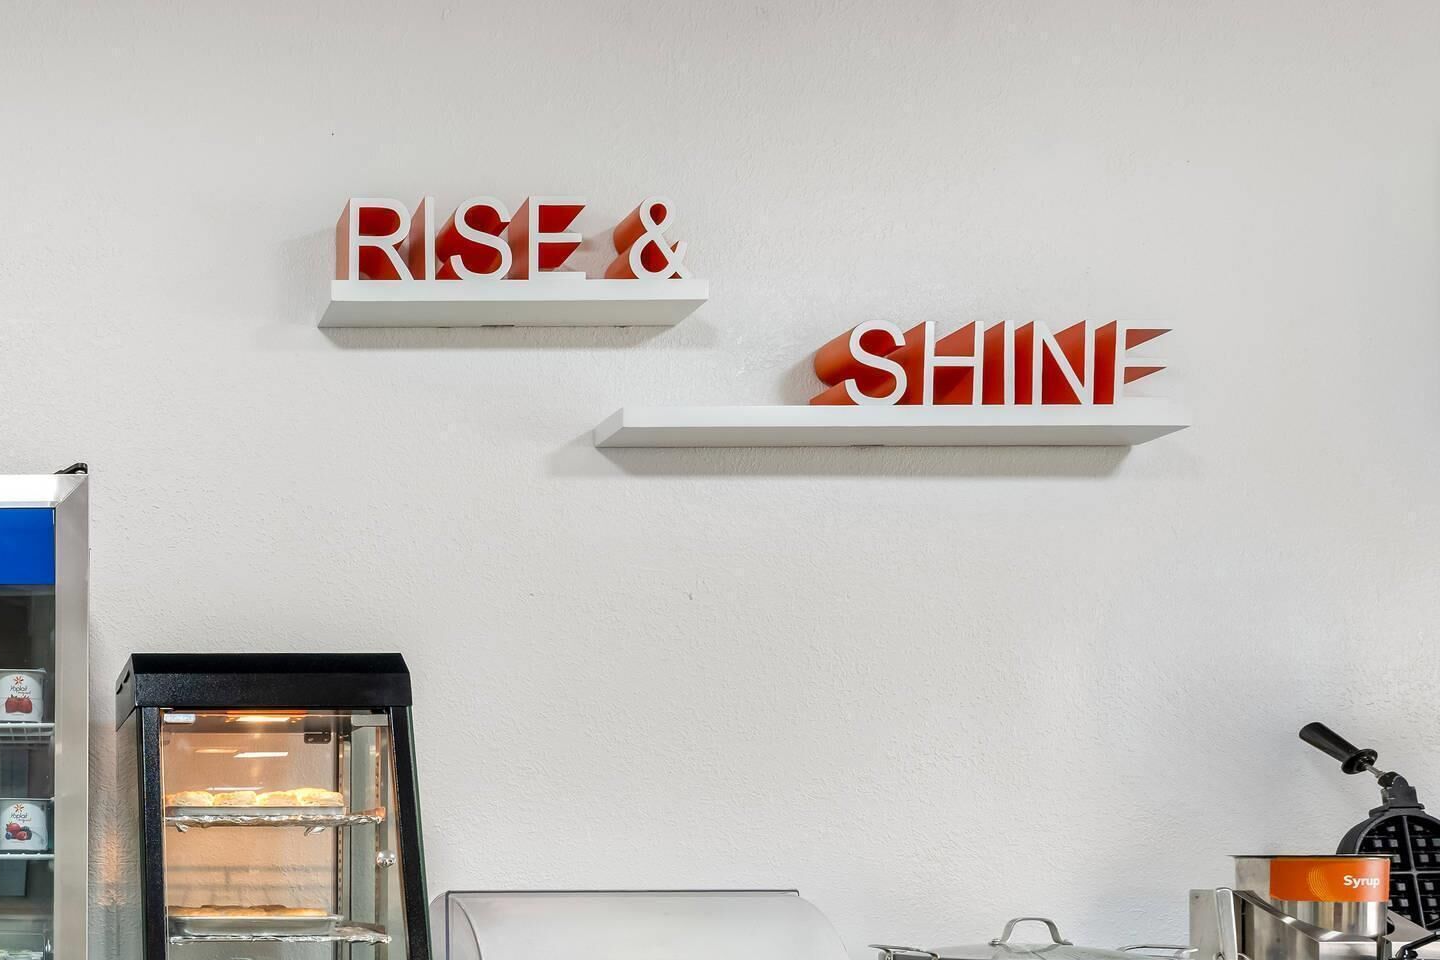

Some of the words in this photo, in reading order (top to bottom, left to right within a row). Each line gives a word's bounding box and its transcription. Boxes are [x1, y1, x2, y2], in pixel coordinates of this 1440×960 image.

[348, 195, 587, 281] RISE
[629, 195, 694, 280] &
[844, 319, 1173, 405] SHINE
[1343, 874, 1381, 889] Syrup
